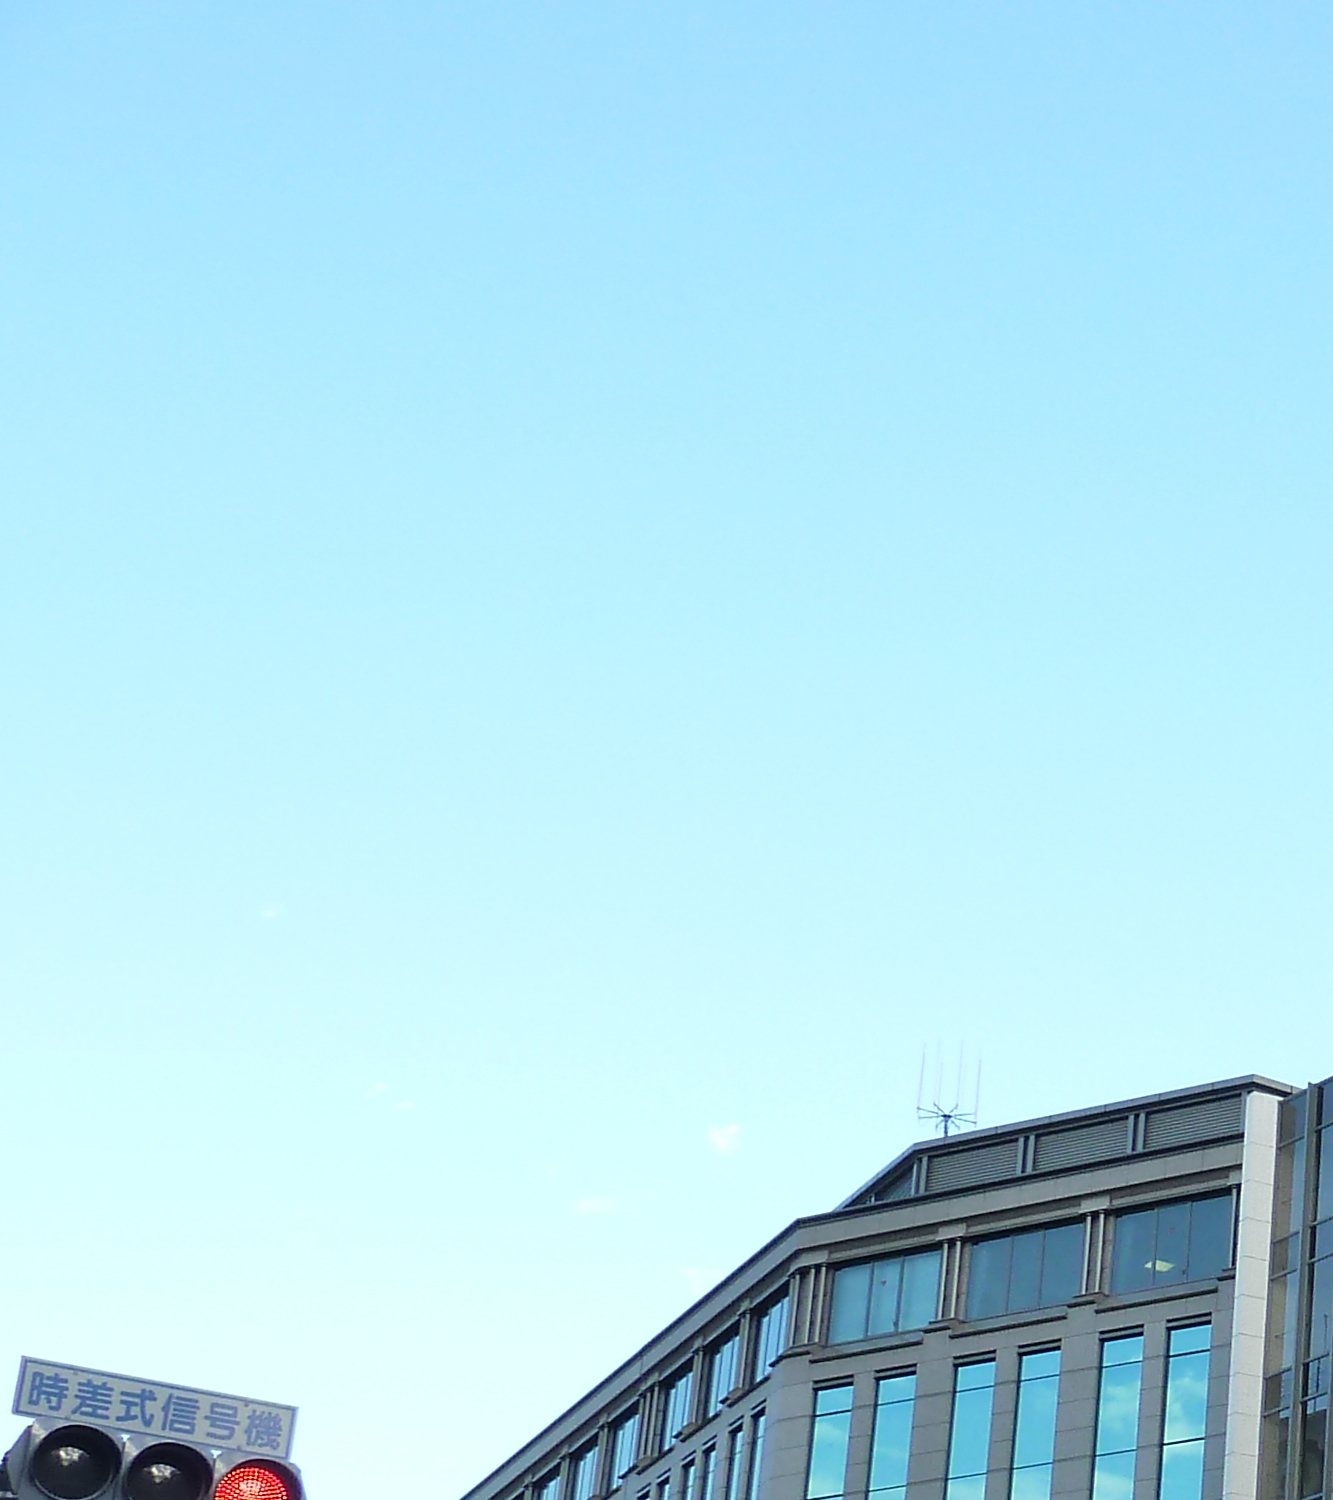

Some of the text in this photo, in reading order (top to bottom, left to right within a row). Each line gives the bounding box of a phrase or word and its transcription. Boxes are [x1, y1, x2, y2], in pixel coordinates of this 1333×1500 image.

[27, 1371, 283, 1450] 時差式信号機
